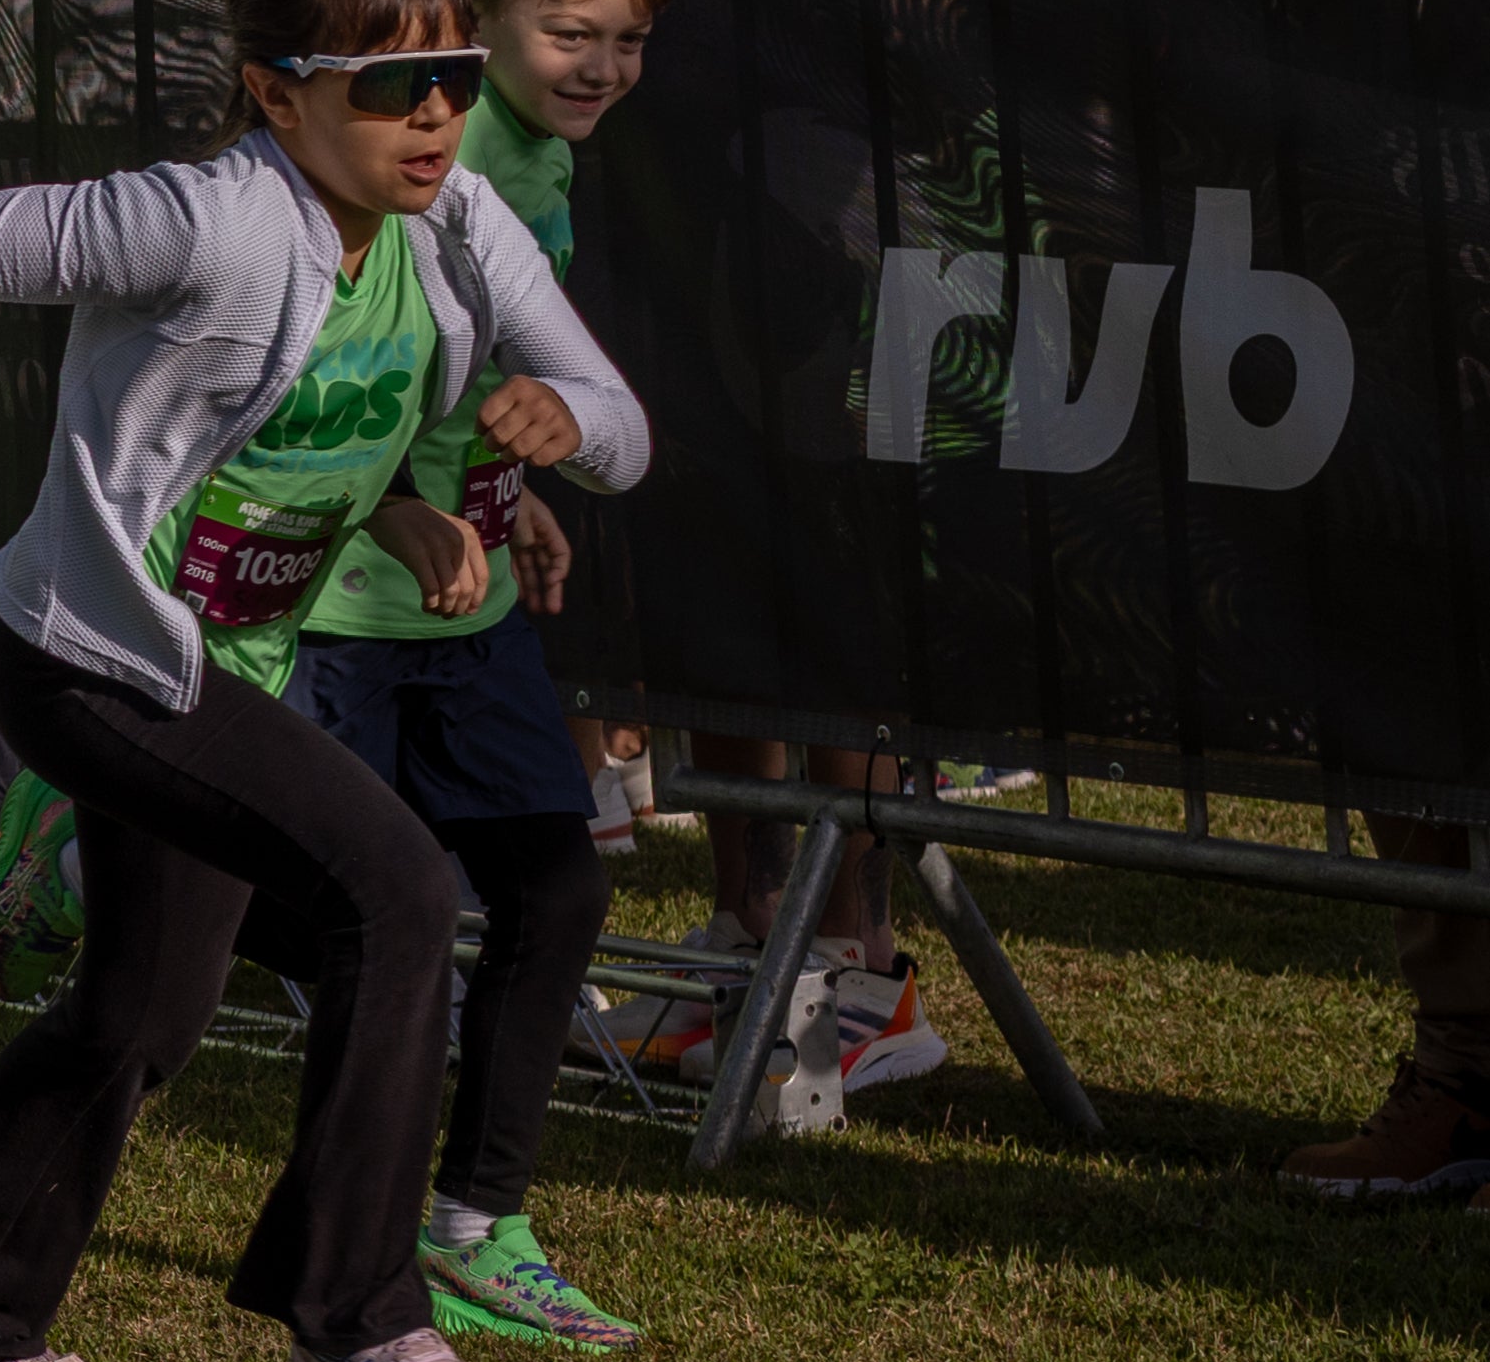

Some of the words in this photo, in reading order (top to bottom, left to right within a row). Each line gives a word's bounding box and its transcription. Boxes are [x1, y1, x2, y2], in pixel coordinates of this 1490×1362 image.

[867, 186, 1355, 492] rvb
[493, 461, 525, 506] 100
[238, 501, 296, 527] ATHENAS
[184, 563, 216, 584] 2018
[197, 536, 229, 554] 100m
[235, 547, 323, 586] 10309
